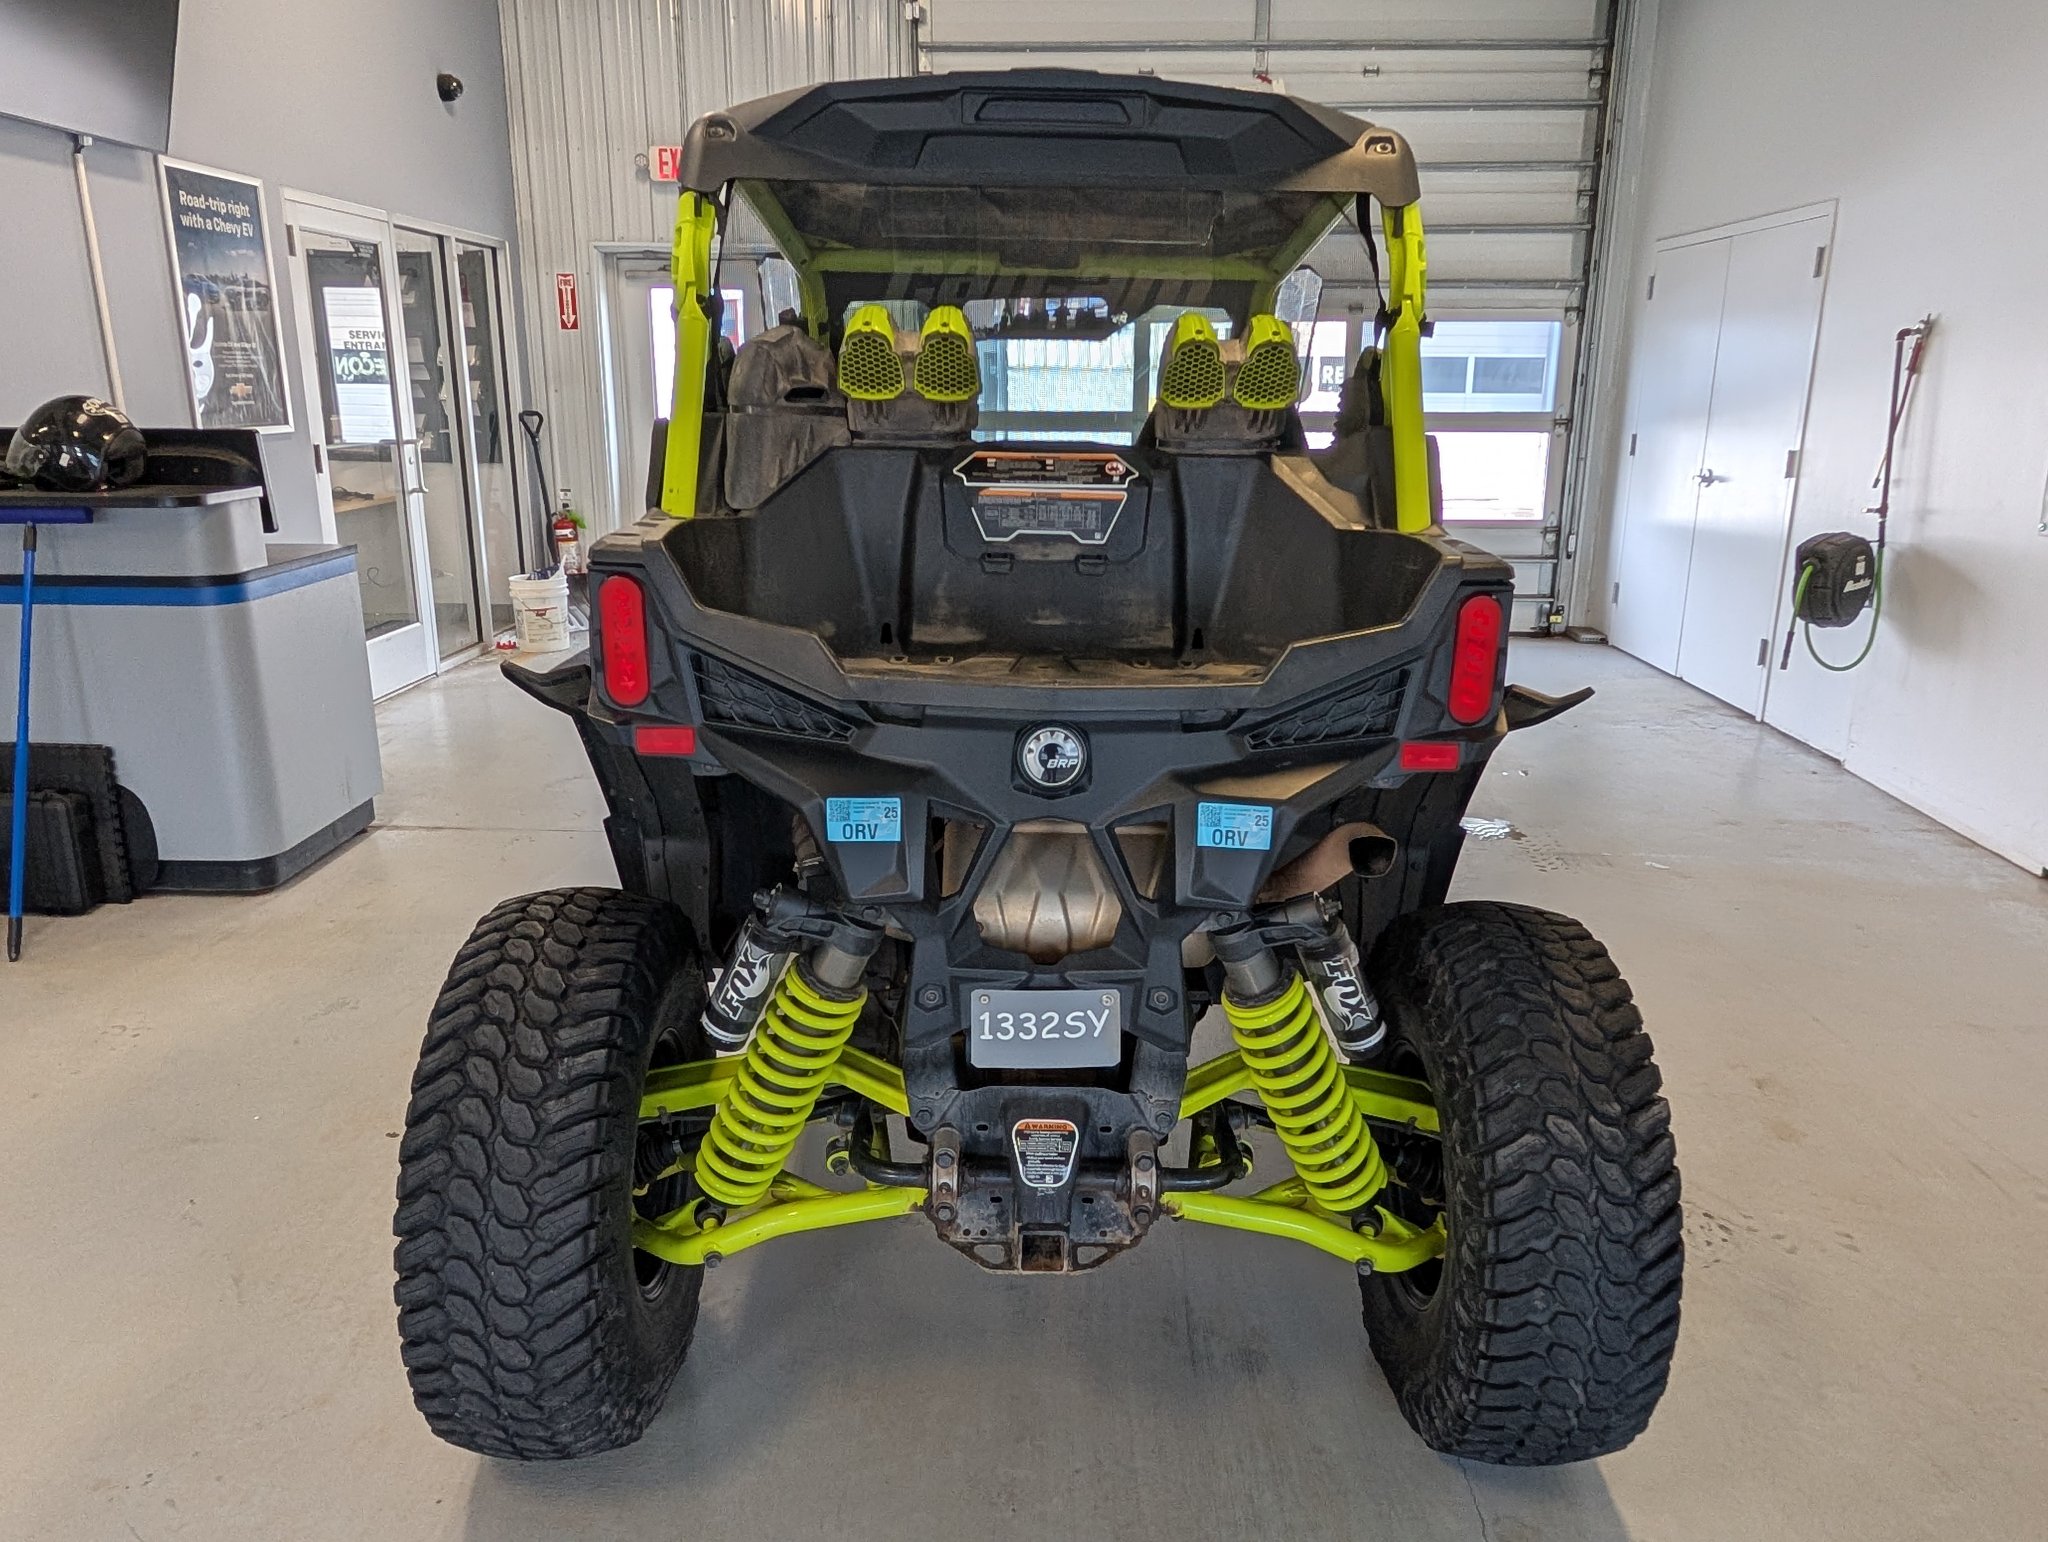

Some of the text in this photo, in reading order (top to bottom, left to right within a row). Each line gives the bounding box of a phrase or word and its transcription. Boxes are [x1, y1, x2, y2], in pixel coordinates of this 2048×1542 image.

[179, 190, 251, 218] Road-trip right
[180, 212, 254, 238] with a Chevy EV
[1321, 365, 1345, 385] RE
[1046, 758, 1079, 769] BRP
[884, 806, 898, 819] 25
[1254, 814, 1269, 827] 25
[842, 823, 879, 840] ORV
[1212, 828, 1249, 847] ORV
[718, 940, 768, 1020] FOX
[1323, 958, 1373, 1023] FOX
[979, 1008, 1110, 1041] 1332SY
